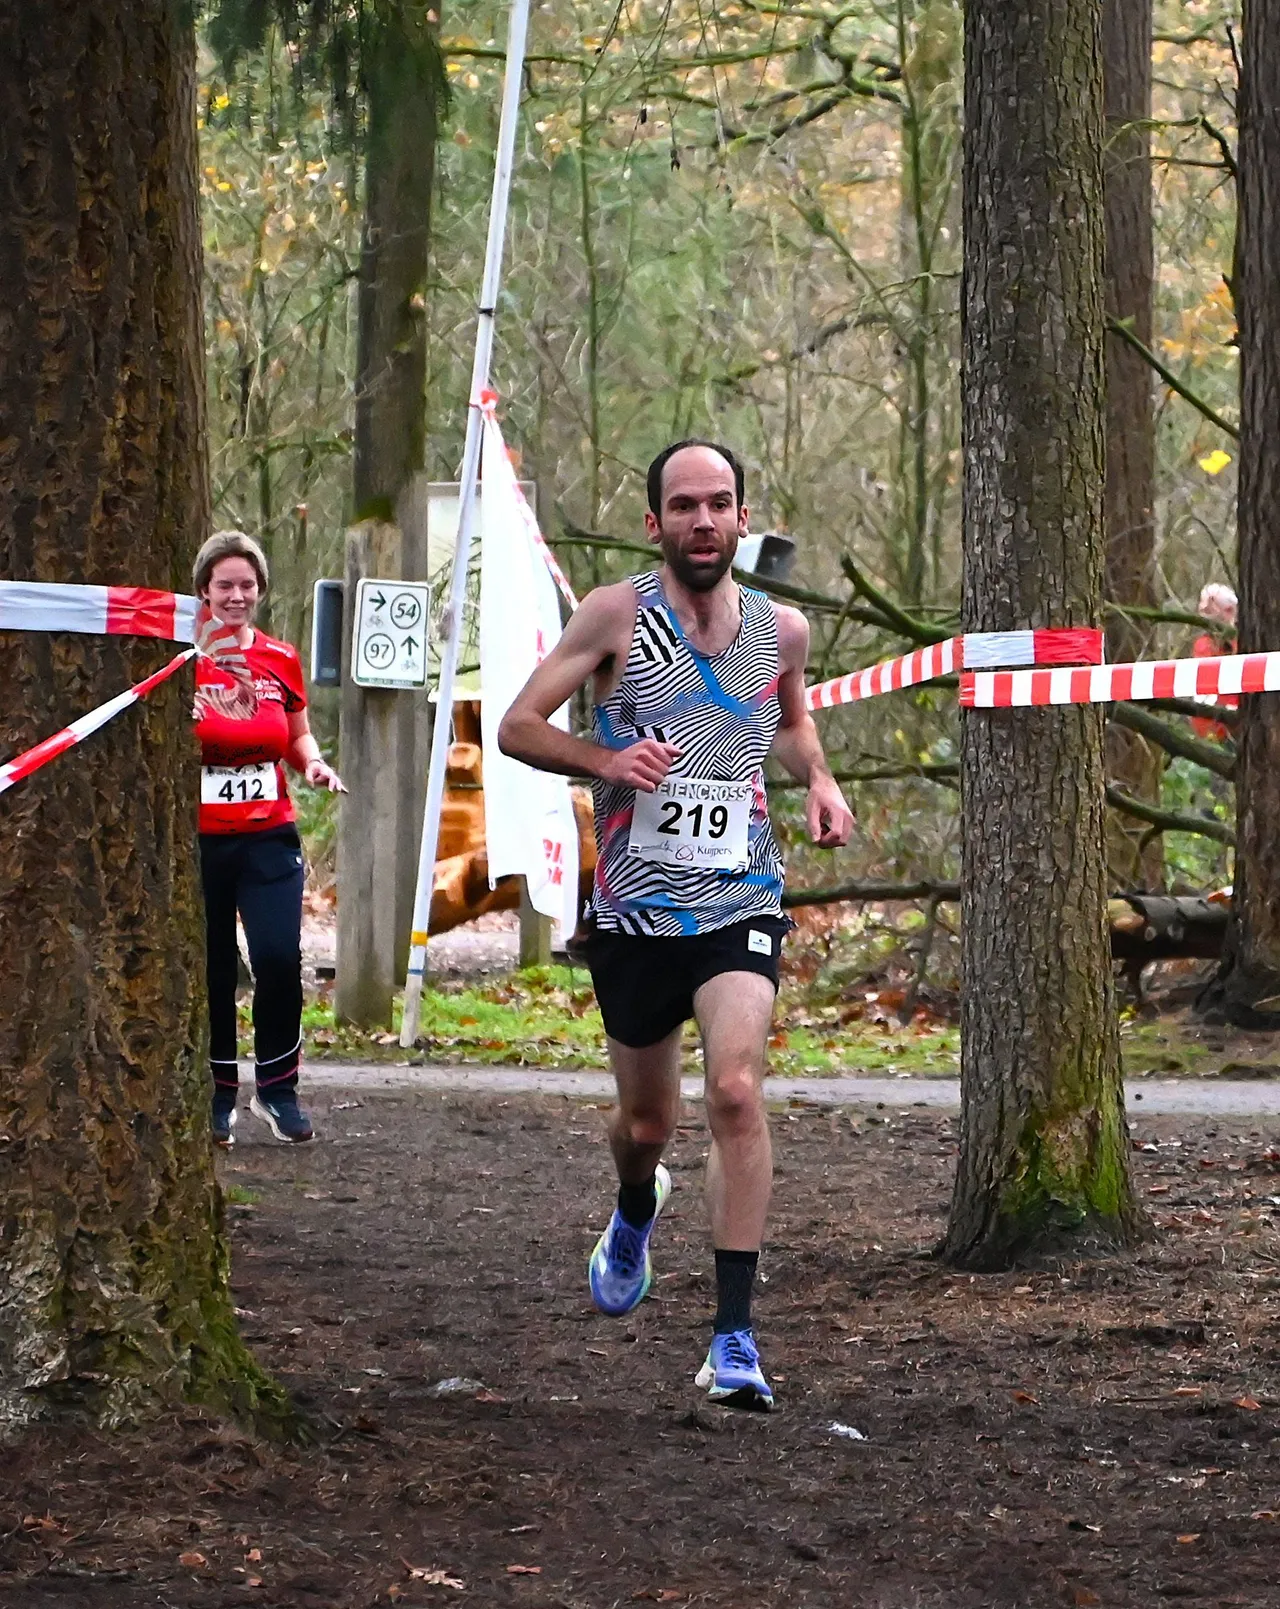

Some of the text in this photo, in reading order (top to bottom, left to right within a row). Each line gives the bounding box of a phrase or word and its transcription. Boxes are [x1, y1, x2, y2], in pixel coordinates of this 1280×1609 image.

[395, 602, 417, 620] 54
[369, 643, 390, 660] 97
[218, 778, 265, 802] 412
[657, 801, 729, 839] 219
